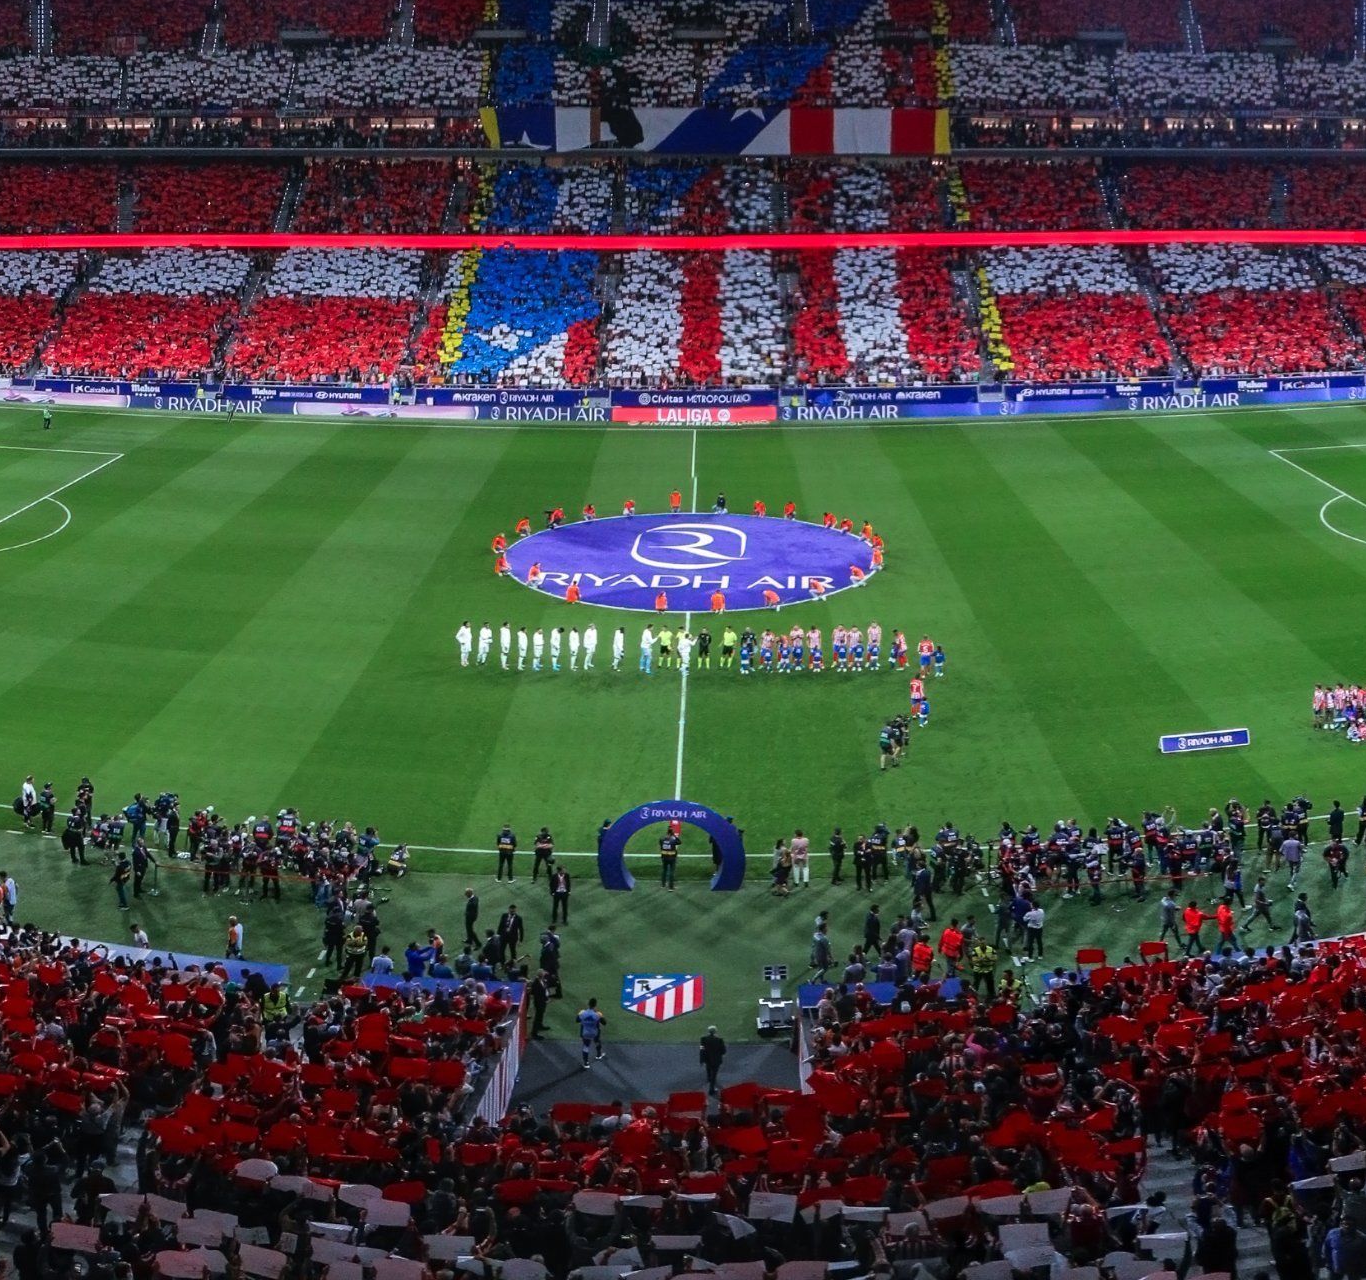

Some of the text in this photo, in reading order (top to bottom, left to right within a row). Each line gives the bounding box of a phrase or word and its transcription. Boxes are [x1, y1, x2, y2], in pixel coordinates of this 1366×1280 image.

[131, 384, 160, 392] Mahou
[509, 394, 540, 402] RIYADH
[540, 394, 554, 402] AIR
[878, 392, 892, 400] AIR
[1143, 392, 1240, 410] RIYADH AIR
[168, 397, 263, 414] RIYADH AIR
[797, 405, 898, 420] RIYADH AIR
[506, 406, 570, 421] RIYADH
[657, 408, 713, 423] LALIGA
[540, 572, 835, 590] RIYADH AIR
[1187, 735, 1233, 746] RIYADH AIR
[651, 809, 707, 819] RIYADH AIR
